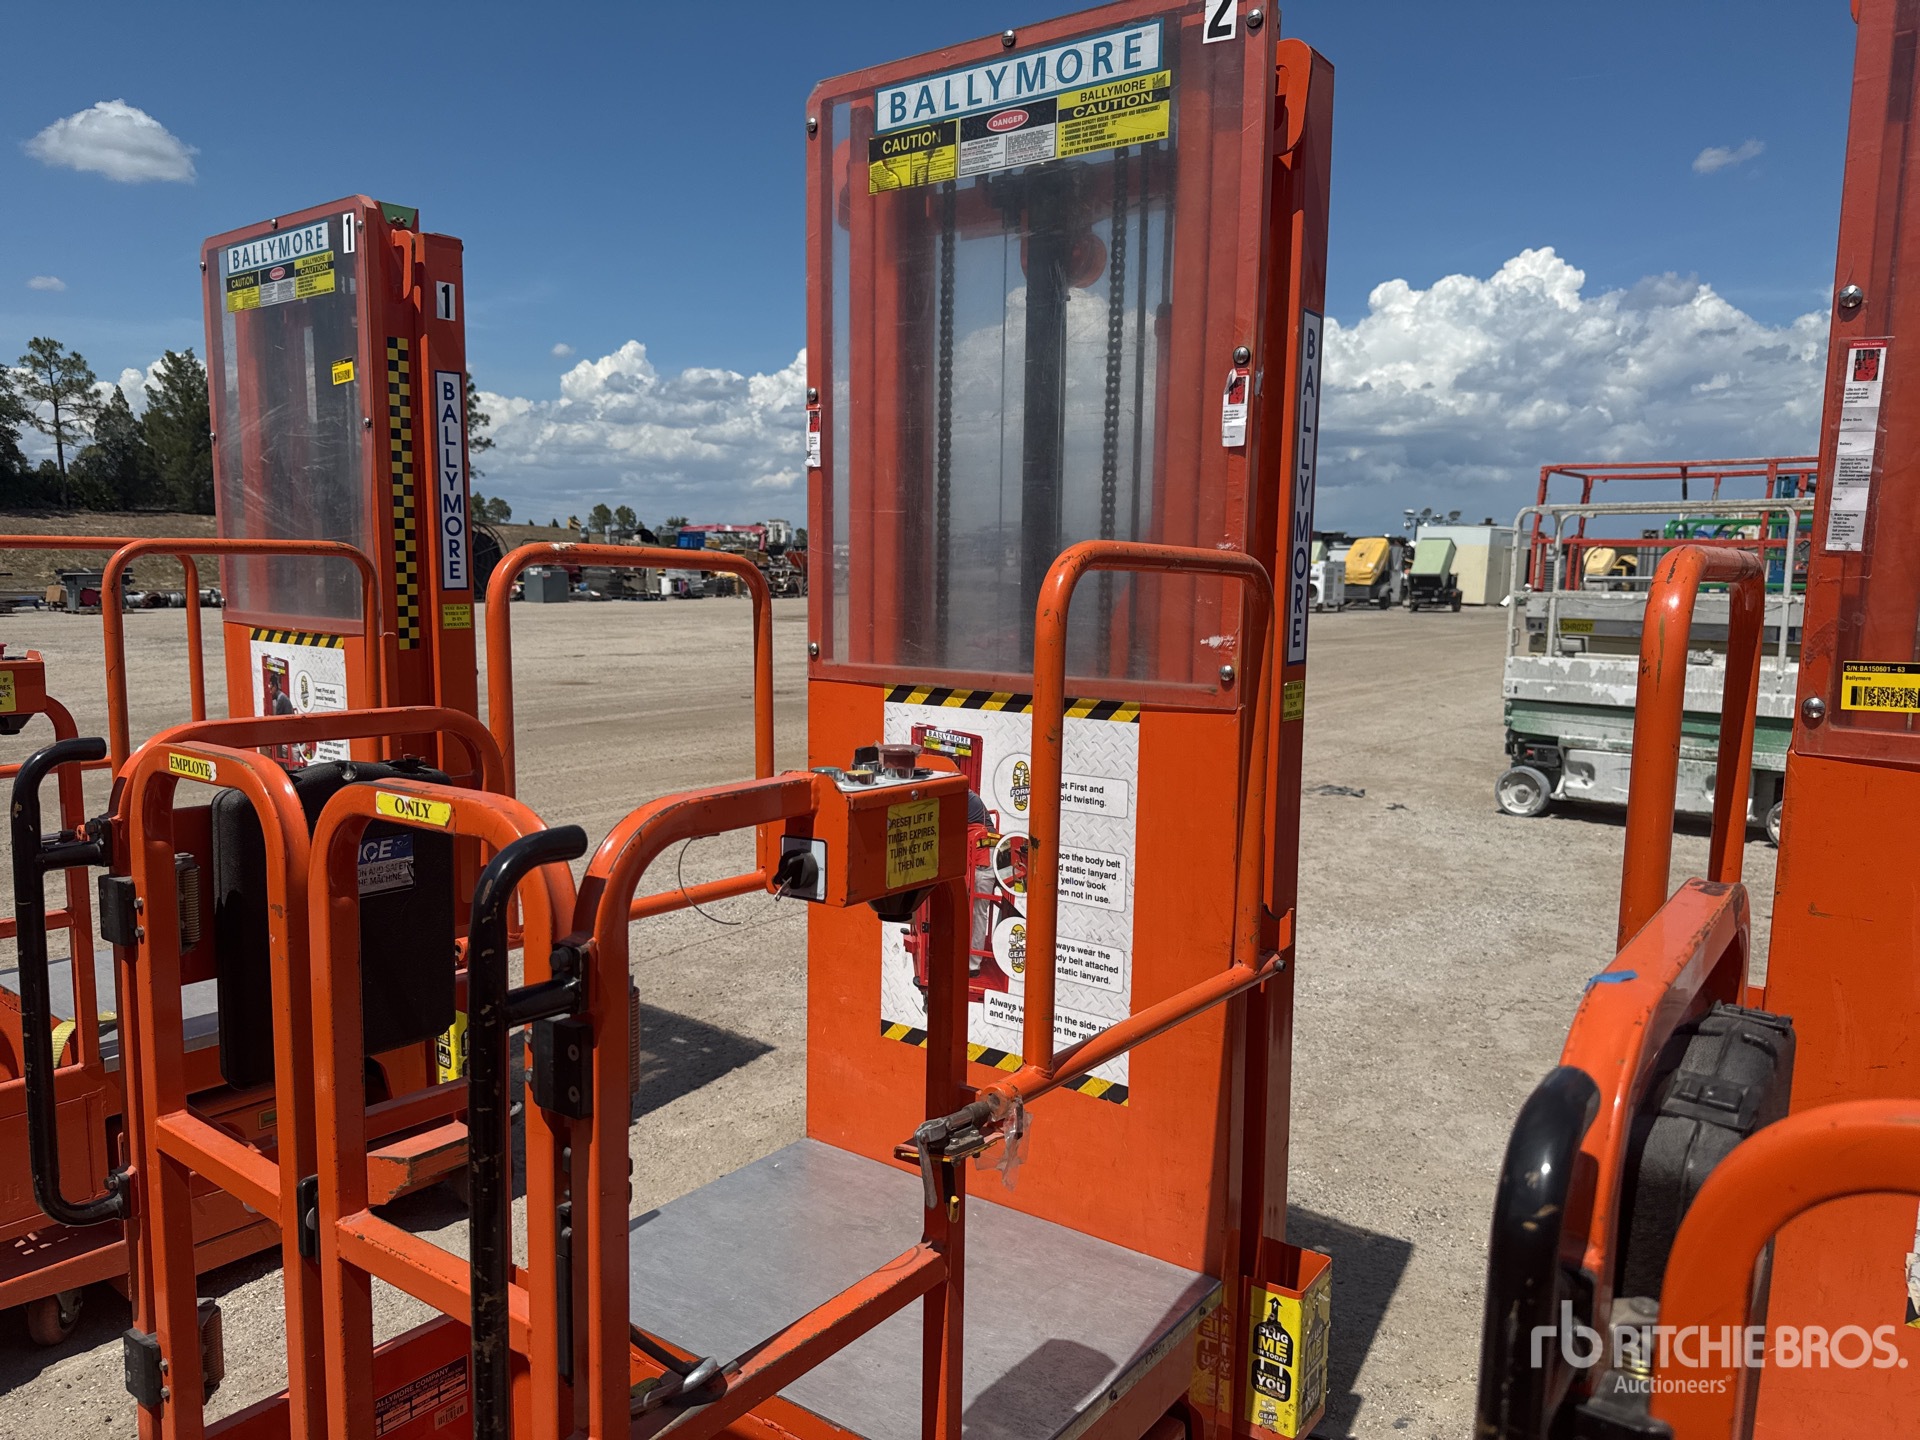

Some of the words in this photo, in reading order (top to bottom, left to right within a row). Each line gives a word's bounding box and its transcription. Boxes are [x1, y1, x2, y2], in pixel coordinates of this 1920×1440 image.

[1207, 0, 1232, 39] 2
[891, 32, 1142, 124] BALLYMORE
[1080, 79, 1146, 102] BALLYMORE
[1073, 92, 1152, 118] CAUTION
[993, 115, 1023, 127] DANGER
[883, 129, 941, 154] CAUTION
[346, 215, 351, 251] 1
[233, 227, 323, 269] BALLYMORE
[301, 263, 328, 275] CAUTION
[302, 255, 325, 266] BALLYMORE
[232, 276, 253, 288] CAUTION
[442, 285, 450, 318] 1
[442, 382, 462, 579] BALLYMORE
[1292, 328, 1315, 647] BALLYMORE
[928, 730, 968, 744] BALLYMORE
[1070, 782, 1087, 791] First
[395, 798, 431, 819] ONLY
[1061, 794, 1071, 802] oid
[1074, 795, 1106, 808] twisting.
[891, 816, 912, 828] RESET
[914, 813, 926, 824] LIFT
[928, 812, 933, 821] IF
[888, 831, 907, 844] TIMER
[910, 826, 936, 840] EXPIRES,
[358, 839, 393, 862] ICE
[890, 847, 907, 858] TURN
[909, 843, 921, 855] KEY
[923, 841, 934, 851] OFF
[898, 861, 914, 872] THEN
[916, 858, 926, 867] ON.
[1072, 854, 1083, 862] the
[1085, 856, 1104, 867] body
[1106, 859, 1120, 868] belt
[1061, 877, 1085, 886] yellow
[1066, 865, 1086, 875] static
[1088, 869, 1116, 880] lanyard
[1071, 891, 1083, 899] not
[1086, 892, 1092, 900] in
[1095, 895, 1110, 904] use.
[1056, 943, 1075, 952] ways
[1077, 947, 1095, 956] wear
[1098, 951, 1110, 959] the
[1069, 956, 1083, 966] belt
[1085, 961, 1118, 974] attached
[1057, 967, 1078, 977] static
[1080, 971, 1111, 984] lanyard.
[990, 997, 1016, 1011] Always
[1065, 1016, 1077, 1025] the
[1080, 1020, 1096, 1031] side
[990, 1009, 1003, 1018] and
[1006, 1014, 1023, 1023] neve
[1064, 1028, 1076, 1037] the
[1259, 1326, 1288, 1344] PLUG
[1258, 1335, 1287, 1358] ME
[1266, 1352, 1287, 1363] TODAY
[376, 1385, 414, 1408] ALLYMORE
[416, 1367, 449, 1389] COMPANY
[1257, 1374, 1285, 1394] YOU
